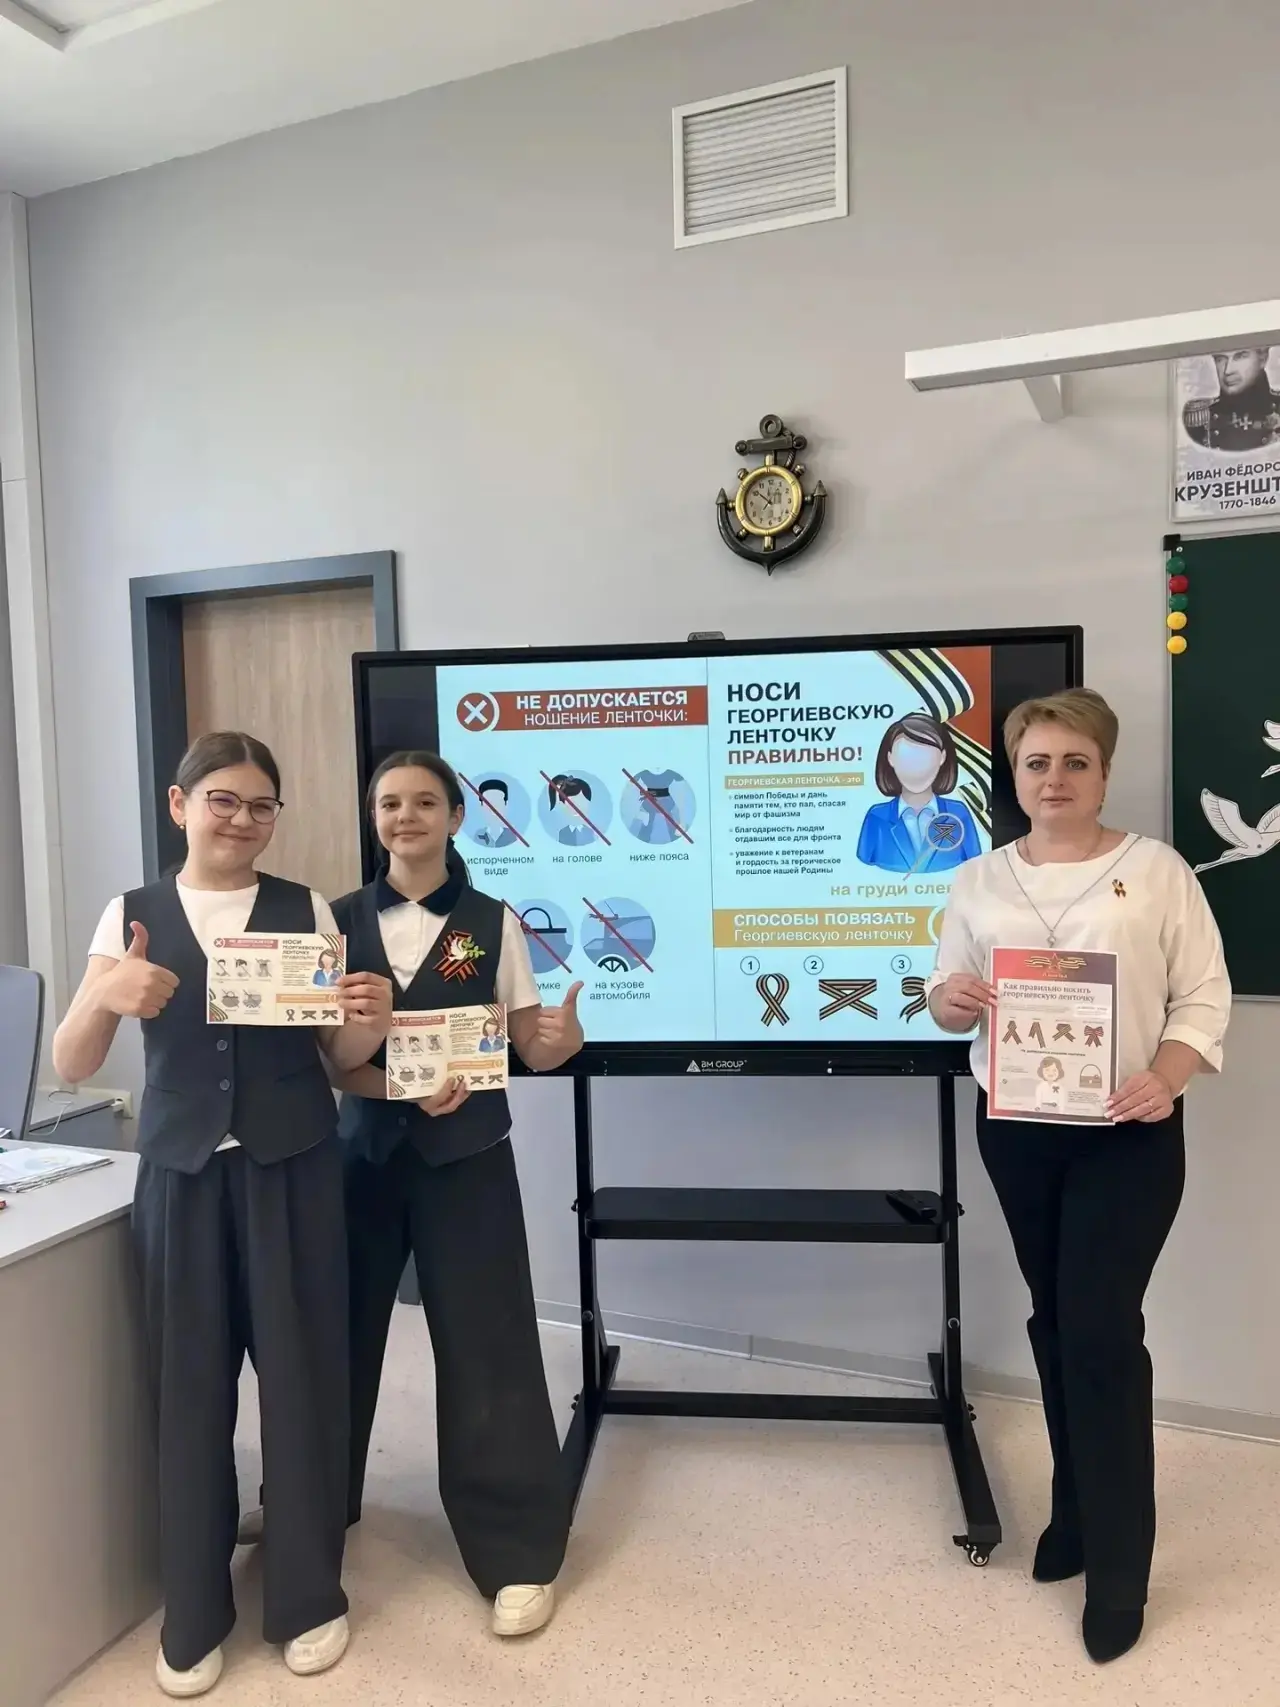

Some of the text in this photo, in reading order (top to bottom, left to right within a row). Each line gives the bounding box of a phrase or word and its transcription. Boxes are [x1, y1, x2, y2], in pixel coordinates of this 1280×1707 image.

[1187, 468, 1221, 481] ИВАН
[1174, 476, 1280, 502] КРУЗЕНШТ
[1219, 496, 1276, 510] 1770-1846
[727, 682, 800, 702] НОСИ
[516, 690, 688, 711] НЕ ДОПУСКАЕТСЯ
[524, 709, 688, 726] НОШЕНИЕ ЛЕНТОЧКИ:
[727, 704, 894, 724] ГЕОРГИЕВСКУЮ
[727, 726, 836, 744] ЛЕНТОЧКУ
[728, 746, 862, 764] ПРАВИЛЬНО!
[728, 777, 793, 786] ГЕОРГИЕВСКАЯ
[795, 776, 840, 784] ЛЕНТОЧКА
[766, 792, 799, 800] Победы
[763, 811, 801, 819] фашизма
[735, 826, 794, 834] благодарность
[811, 834, 841, 842] фронта
[467, 856, 534, 865] испорченном
[568, 854, 602, 863] голове
[630, 853, 656, 862] ниже
[660, 853, 689, 861] пояса
[735, 850, 773, 858] уважение
[791, 858, 841, 866] героическое
[484, 868, 508, 876] виде
[773, 866, 799, 874] нашей
[830, 886, 850, 896] на
[857, 884, 907, 898] груди
[734, 912, 916, 926] СПОСОБЫ ПОВЯЗАТЬ
[734, 929, 913, 944] Георгиевскую ленточку
[747, 961, 753, 970] 1
[810, 960, 818, 970] 2
[898, 960, 905, 969] 3
[537, 982, 560, 990] умке
[610, 981, 644, 990] кузове
[1019, 984, 1061, 992] правильно
[589, 991, 650, 1000] автомобиля
[1058, 994, 1095, 1003] ленточку
